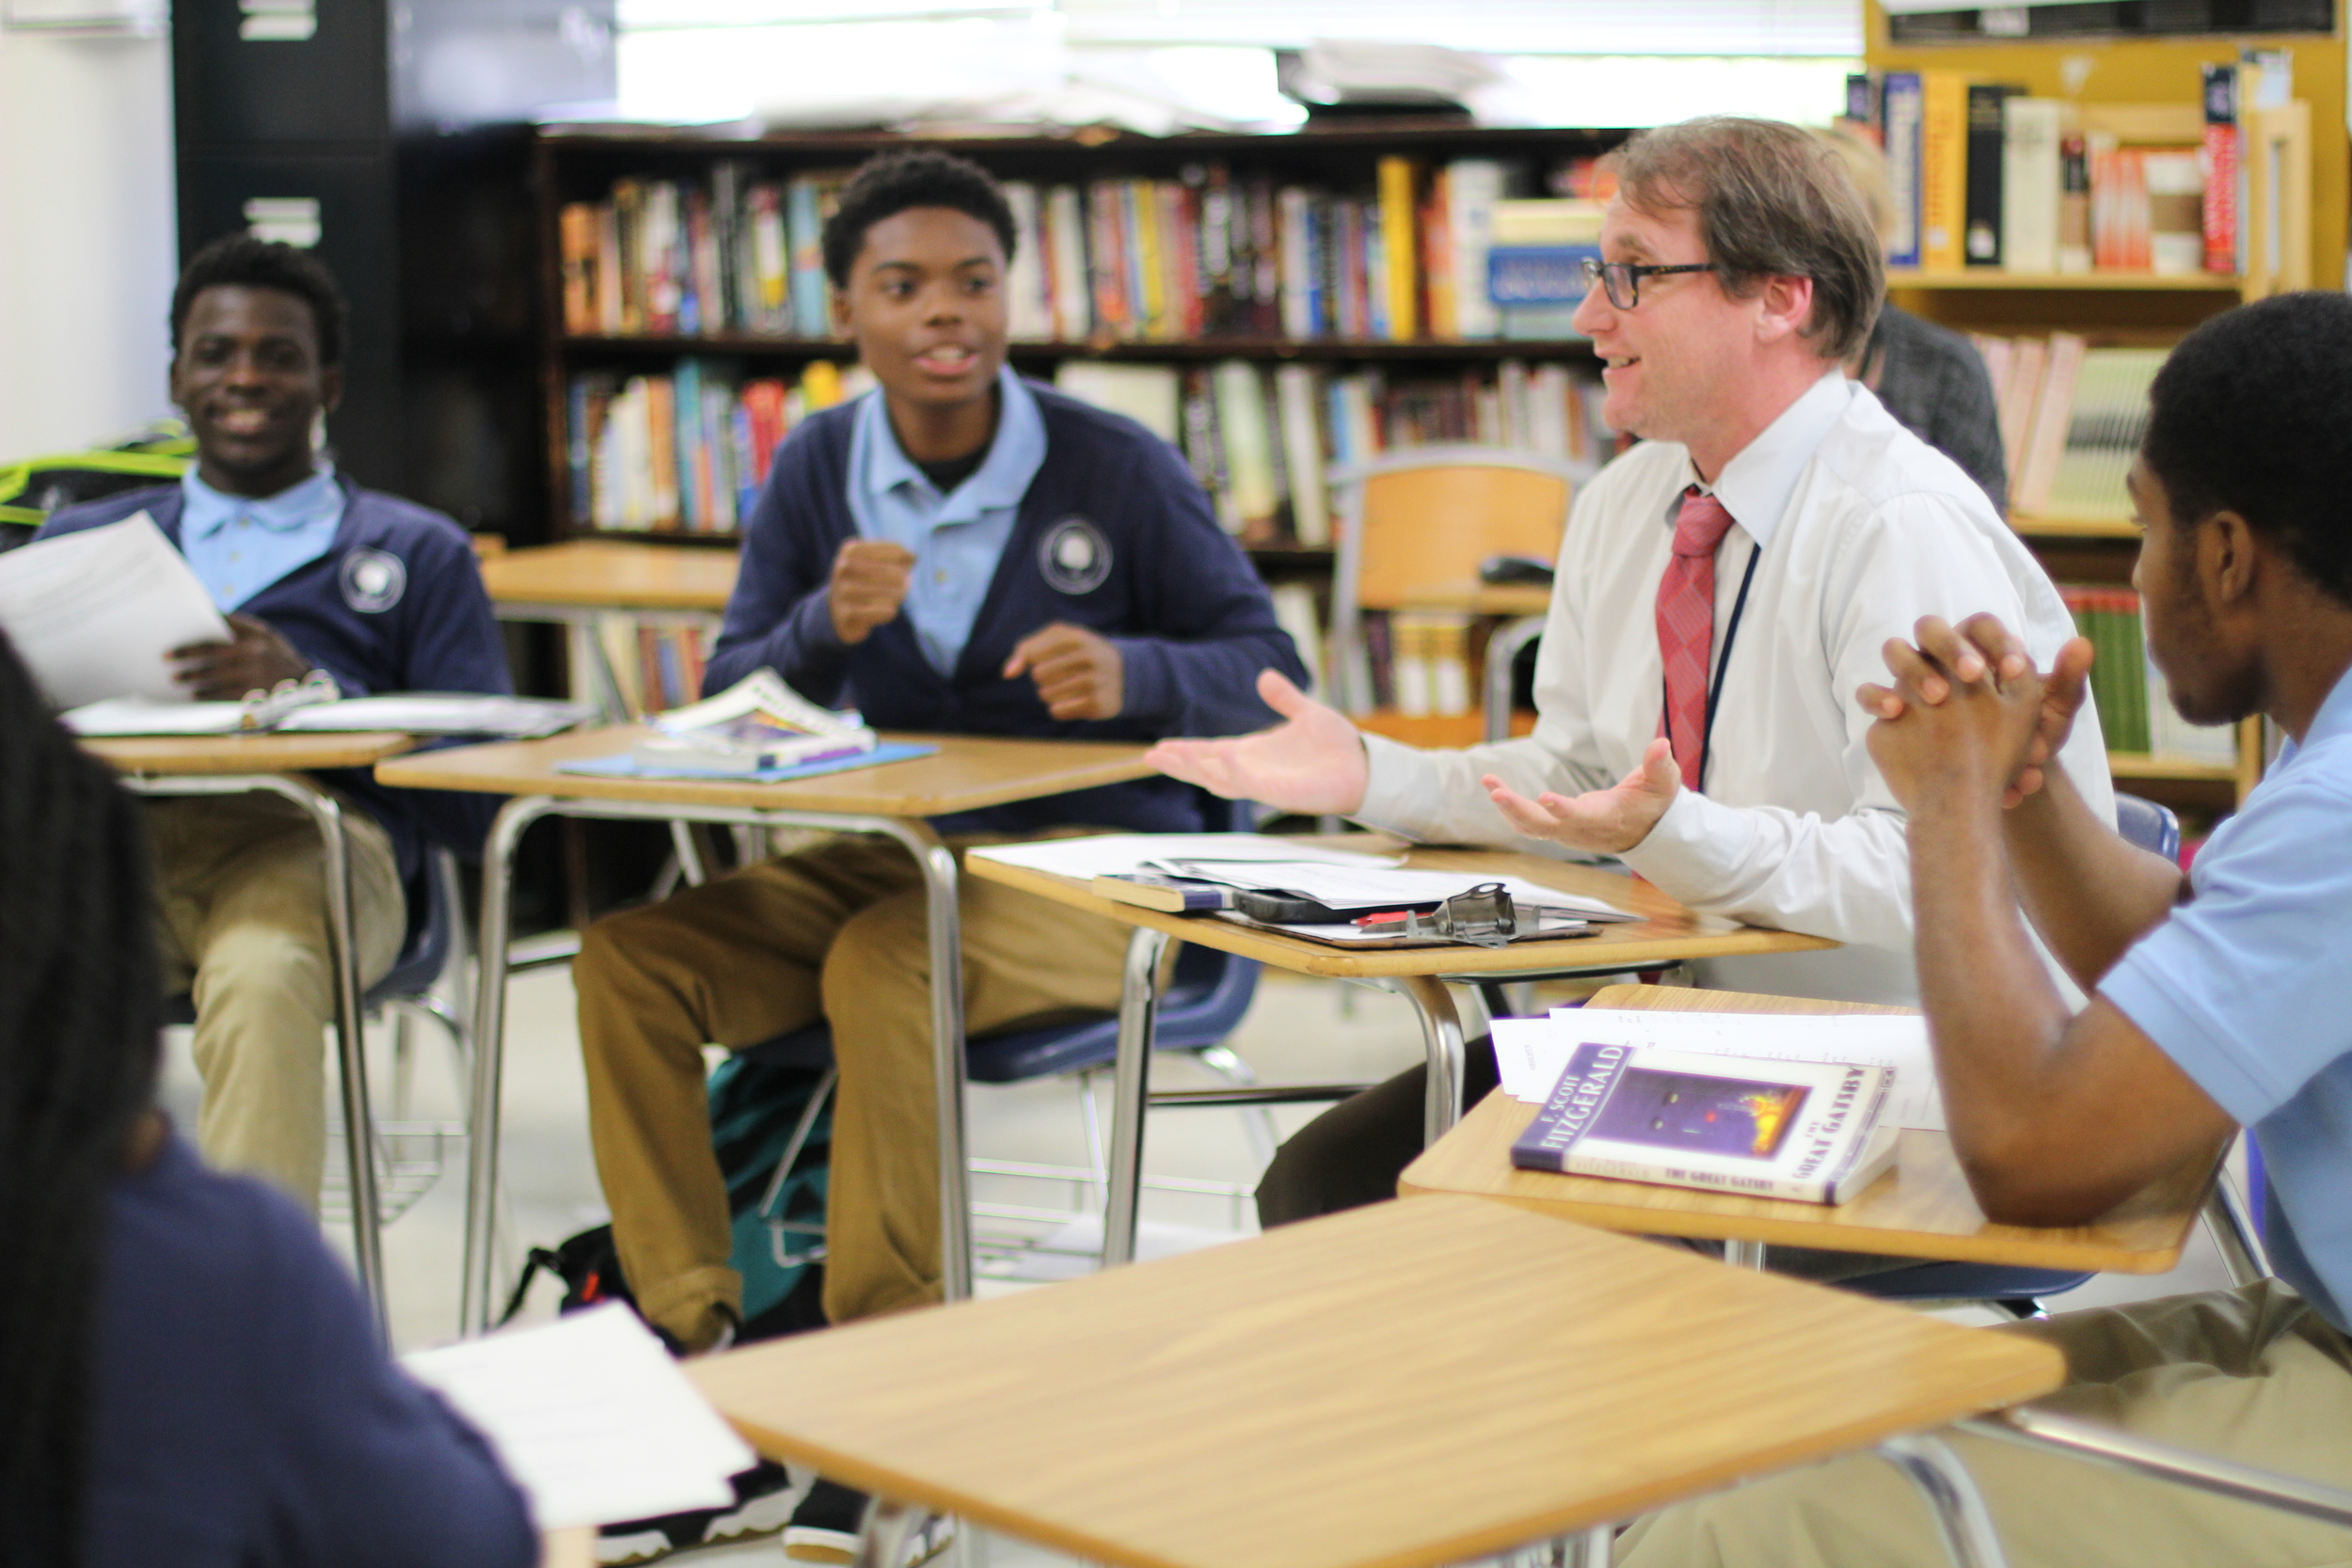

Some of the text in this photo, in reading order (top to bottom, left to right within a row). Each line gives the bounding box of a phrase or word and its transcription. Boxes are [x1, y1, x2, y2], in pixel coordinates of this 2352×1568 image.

[1540, 1046, 1624, 1148] FITZGERALD
[1540, 1075, 1581, 1123] F. SCOTT
[1792, 1067, 1866, 1179] GREAT GATSBY
[1805, 1121, 1820, 1137] THE
[1665, 1167, 1687, 1179] THE
[1692, 1169, 1727, 1184] GREAT
[1731, 1175, 1774, 1192] GATSBY
